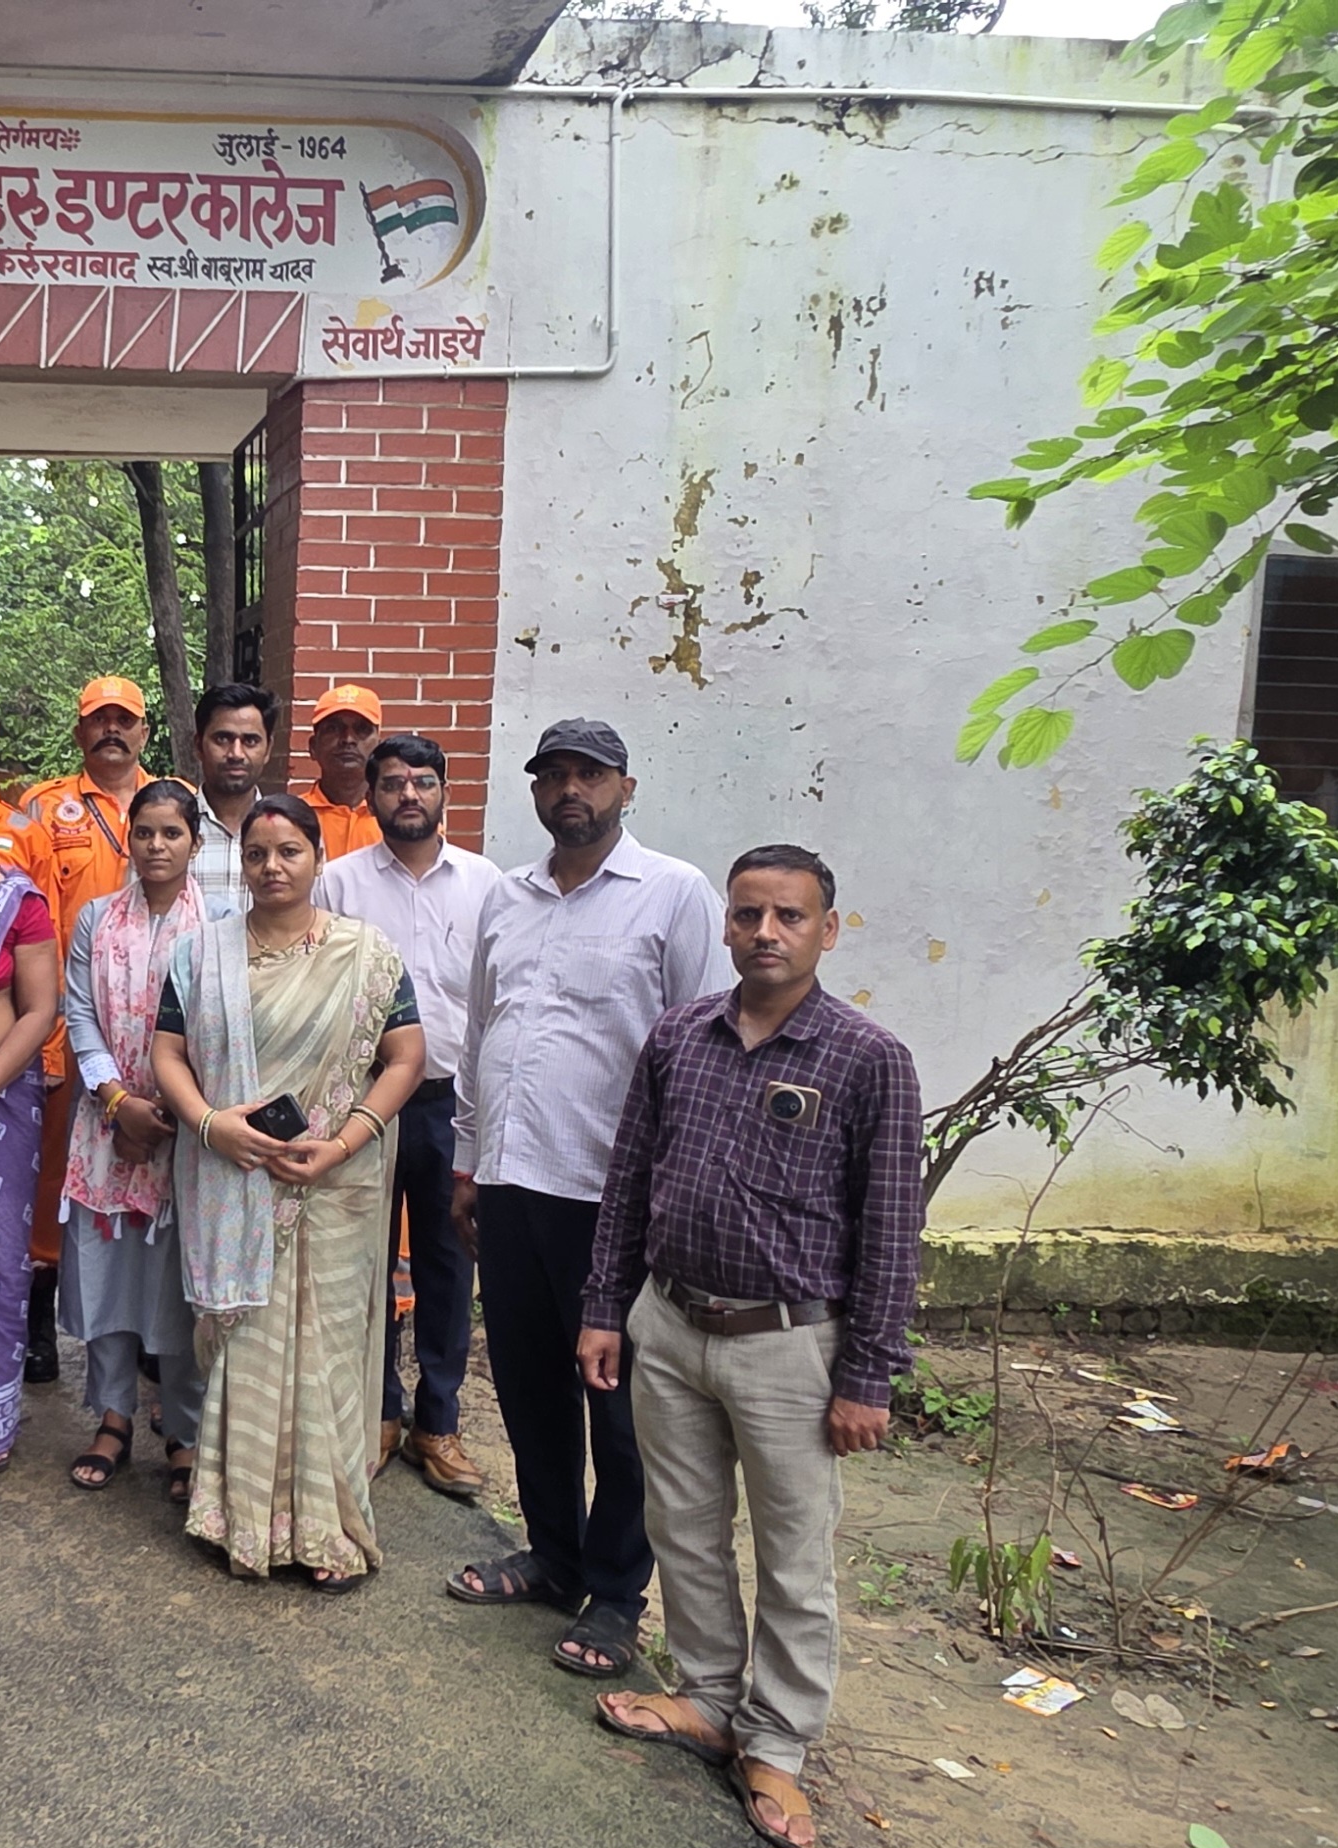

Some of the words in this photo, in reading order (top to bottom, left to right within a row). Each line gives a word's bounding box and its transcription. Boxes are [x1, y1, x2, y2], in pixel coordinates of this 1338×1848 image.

[212, 128, 280, 167] जुलाई
[298, 135, 347, 160] 1964
[269, 258, 316, 284] यादव
[322, 314, 406, 364] सेवार्थ
[405, 316, 485, 365] जाइये
